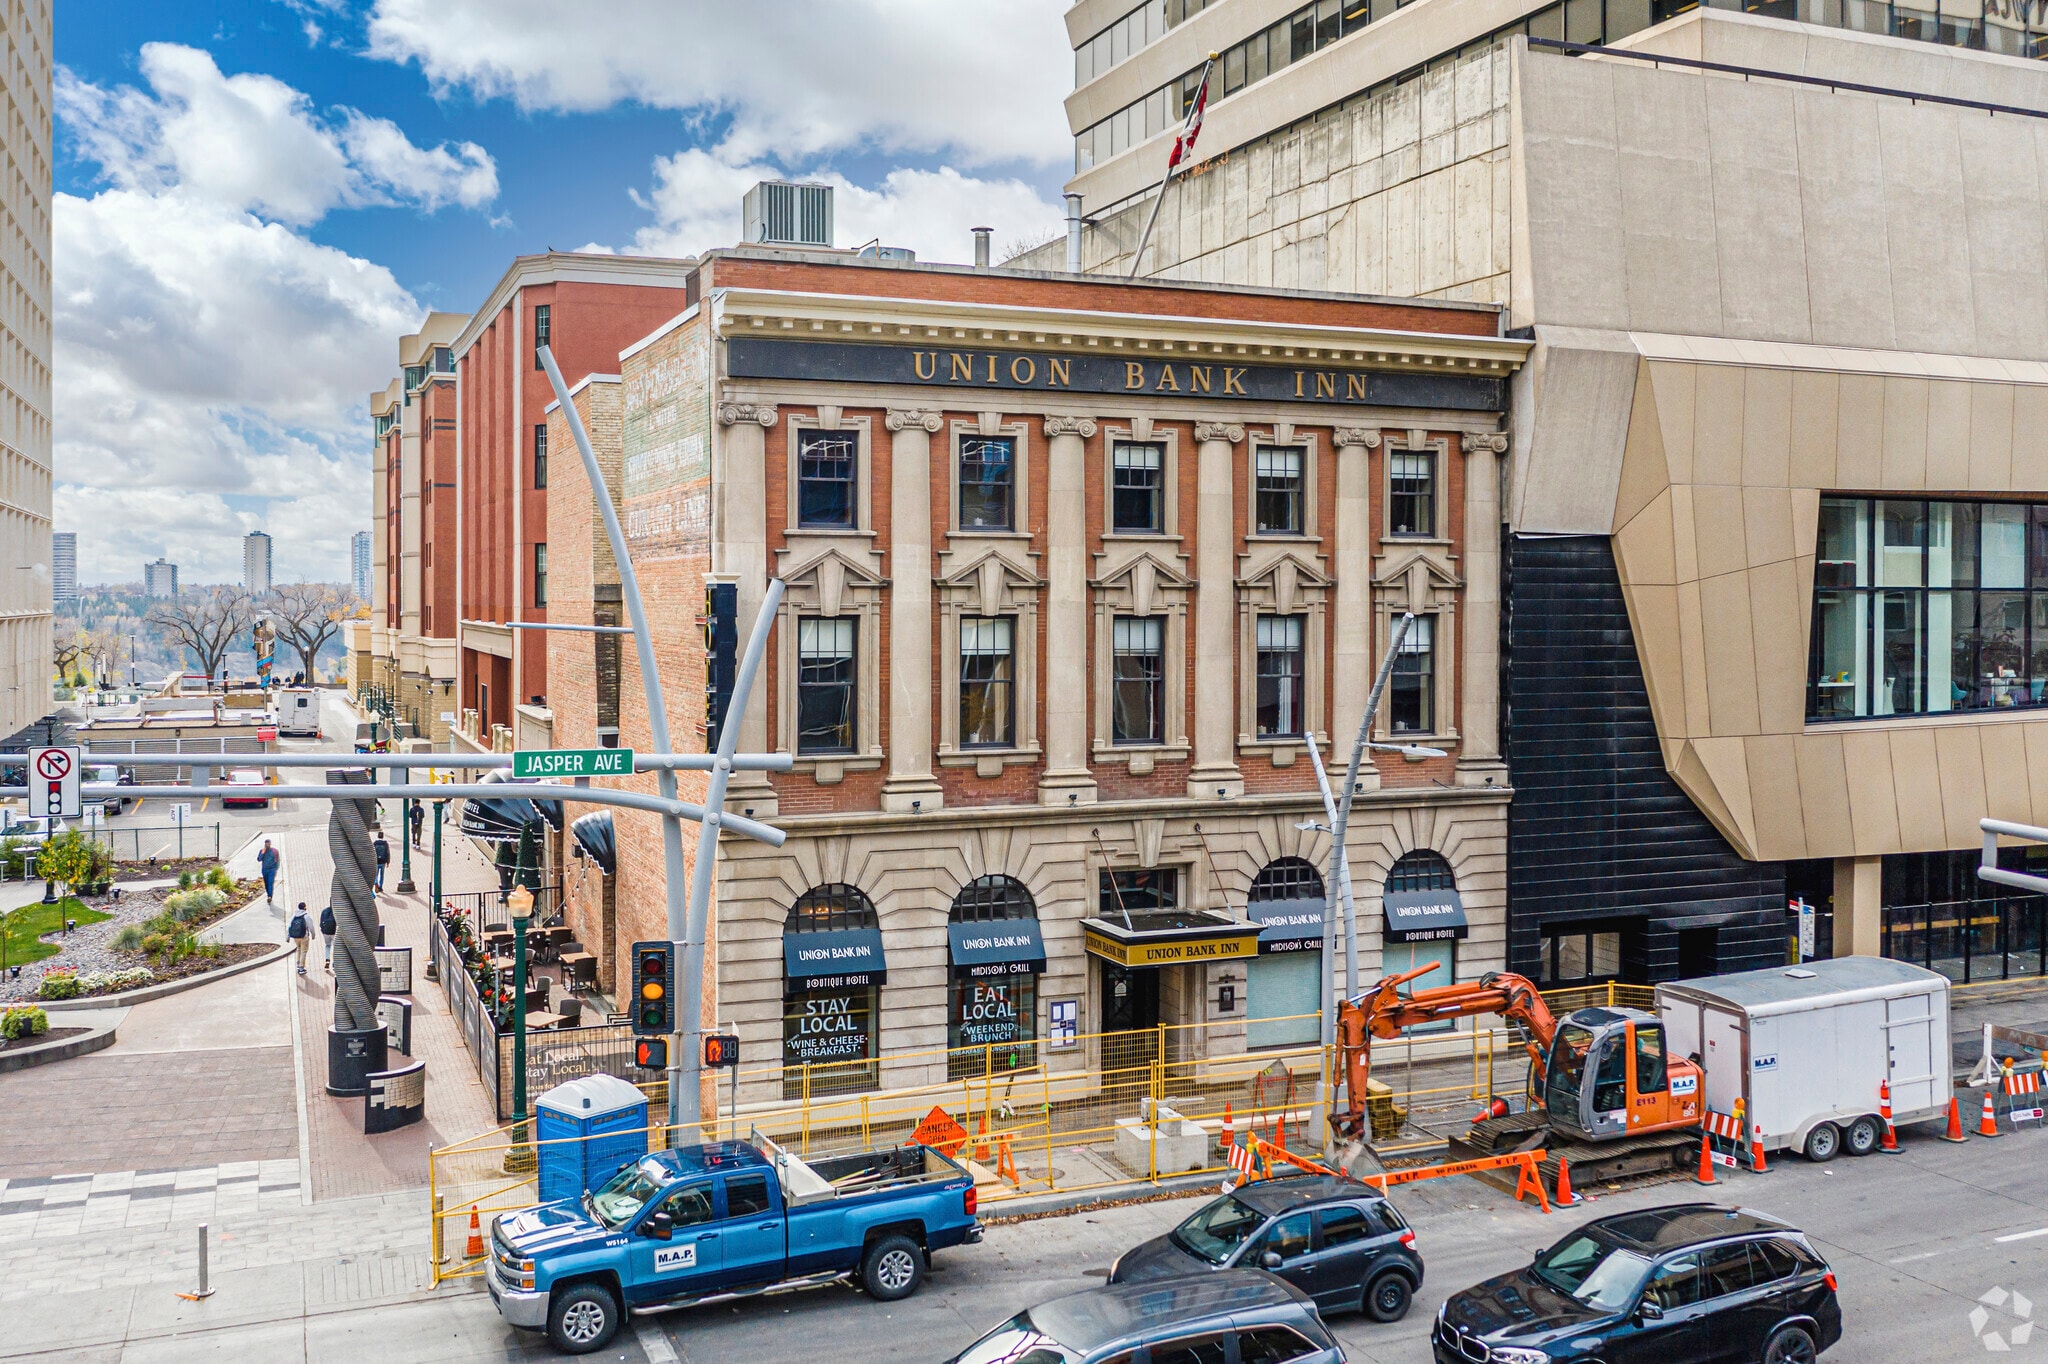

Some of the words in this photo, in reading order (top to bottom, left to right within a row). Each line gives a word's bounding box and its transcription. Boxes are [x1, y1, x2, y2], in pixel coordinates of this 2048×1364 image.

[913, 351, 1072, 386] UNION
[1125, 361, 1247, 395] BANK
[1294, 371, 1368, 400] INN
[525, 755, 583, 772] JASPER
[594, 754, 622, 770] AVE
[1396, 906, 1422, 917] UNION
[1422, 905, 1440, 915] BANK
[1441, 904, 1454, 914] INN
[1261, 916, 1288, 928] UNION
[1289, 914, 1308, 925] BANK
[1309, 913, 1322, 923] INN
[1405, 930, 1435, 941] BOUTIQUE
[1436, 929, 1455, 939] HOTEL
[963, 938, 992, 950] UNION
[994, 936, 1016, 948] BANK
[1017, 935, 1031, 946] INN
[1270, 939, 1302, 951] MADISON'S
[1304, 939, 1322, 950] GRILL
[799, 949, 830, 961] UNION
[832, 947, 855, 959] BANK
[856, 945, 871, 957] INN
[1147, 947, 1181, 960] UNION
[1186, 944, 1216, 957] BANK
[1221, 942, 1240, 954] INN
[971, 963, 1007, 977] MADISON'S
[1010, 963, 1030, 973] GRILL
[806, 976, 843, 988] BOUTIQUE
[846, 975, 869, 985] HOTEL
[974, 985, 1007, 1003] EAT
[806, 997, 851, 1016] STAY
[963, 1002, 1017, 1020] LOCAL
[800, 1014, 858, 1035] LOCAL
[966, 1022, 1015, 1035] WEEKEND
[791, 1038, 817, 1050] WINE
[819, 1038, 827, 1046] &
[829, 1035, 865, 1046] CHEESE
[970, 1031, 1011, 1043] BRUNCH
[545, 1049, 583, 1063] Local.
[800, 1044, 858, 1057] BREAKFAST
[552, 1061, 591, 1075] Local.
[1755, 1057, 1776, 1067] M.A.P.
[1673, 1080, 1695, 1089] M.A.P.
[1636, 1097, 1656, 1106] E113
[921, 1122, 953, 1135] DANGER
[929, 1136, 946, 1144] OPEN
[658, 1249, 693, 1263] M.A.P.
